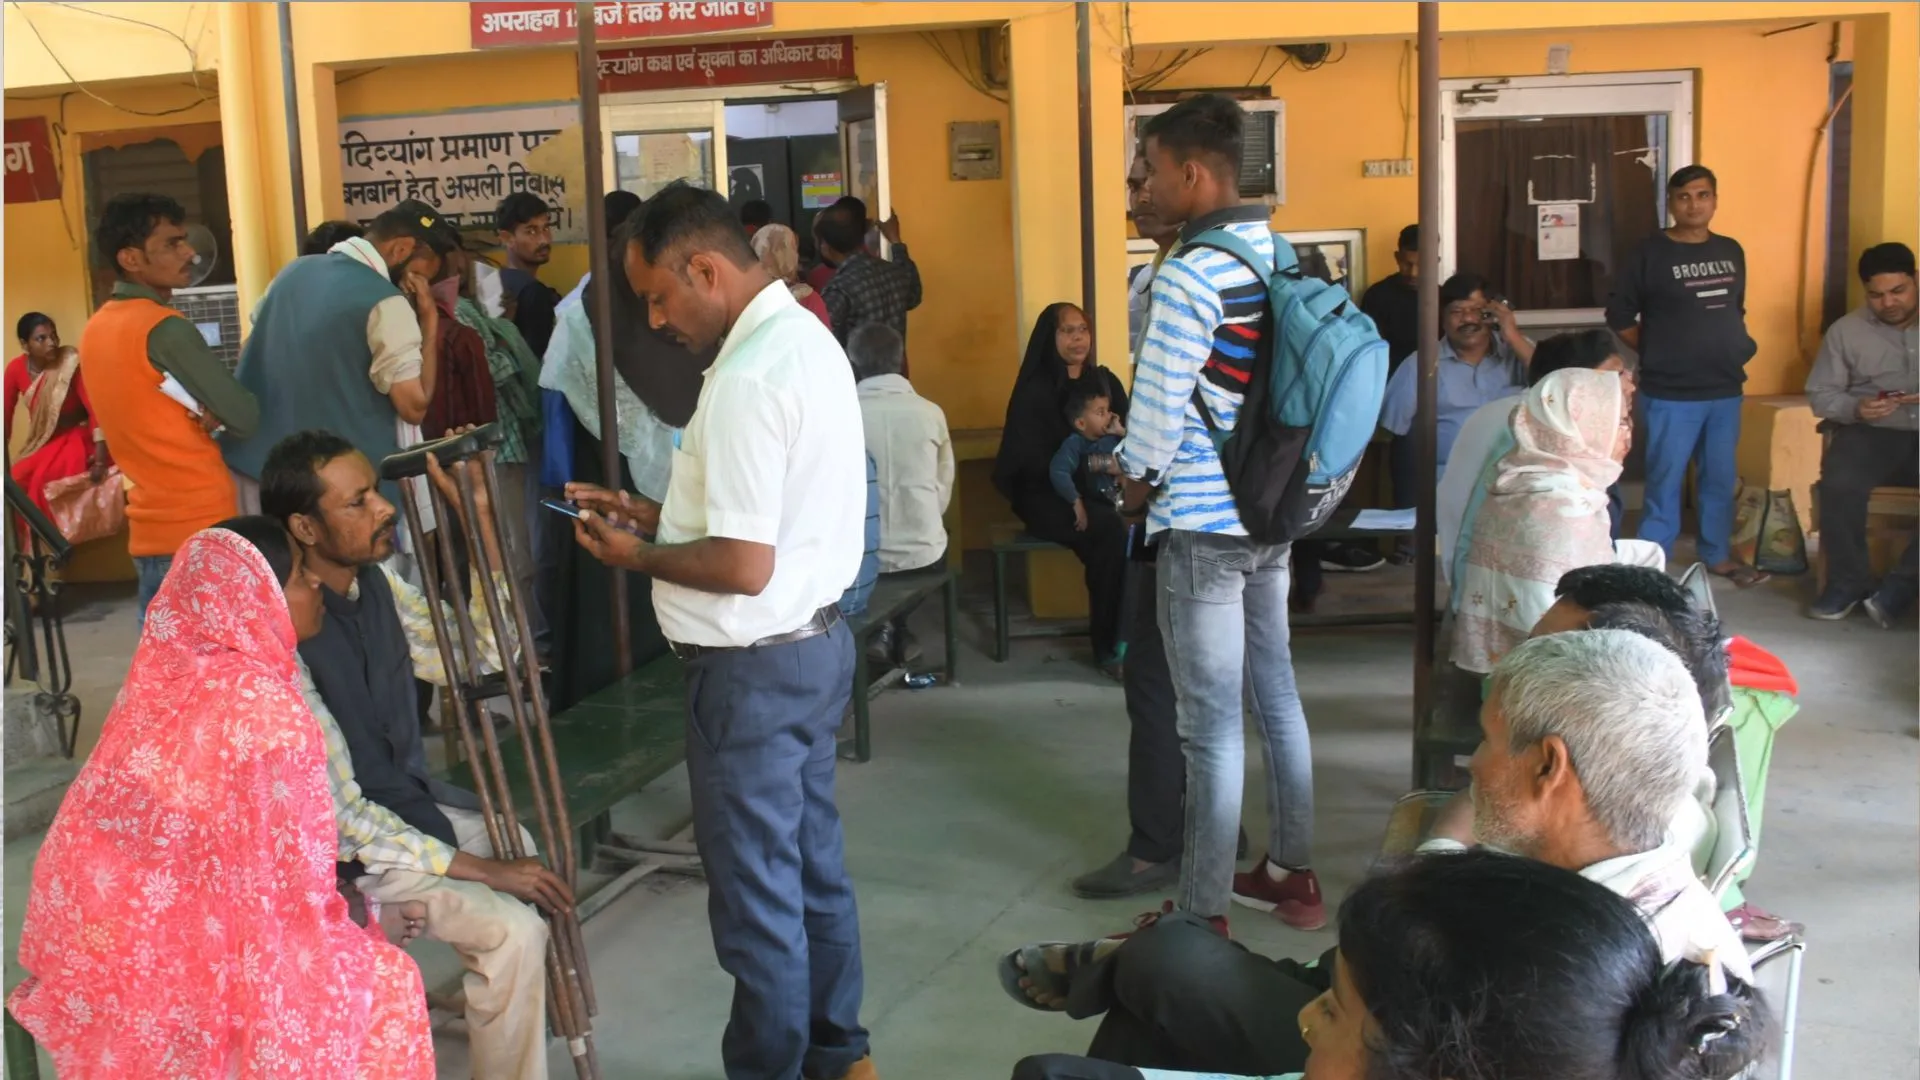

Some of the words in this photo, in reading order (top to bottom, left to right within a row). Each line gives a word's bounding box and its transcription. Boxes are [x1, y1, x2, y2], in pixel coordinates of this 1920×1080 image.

[481, 9, 560, 32] अपराहन
[628, 2, 663, 23] तक
[646, 54, 673, 72] कक्ष
[675, 47, 696, 71] एवं
[698, 51, 736, 78] सूचना
[738, 49, 758, 66] का
[760, 40, 814, 65] अधिकार
[816, 43, 844, 61] कक्ष
[340, 130, 435, 171] दिव्यांग
[438, 132, 514, 163] प्रमाण
[442, 164, 505, 201] असली
[1672, 260, 1736, 279] BROOKLYN
